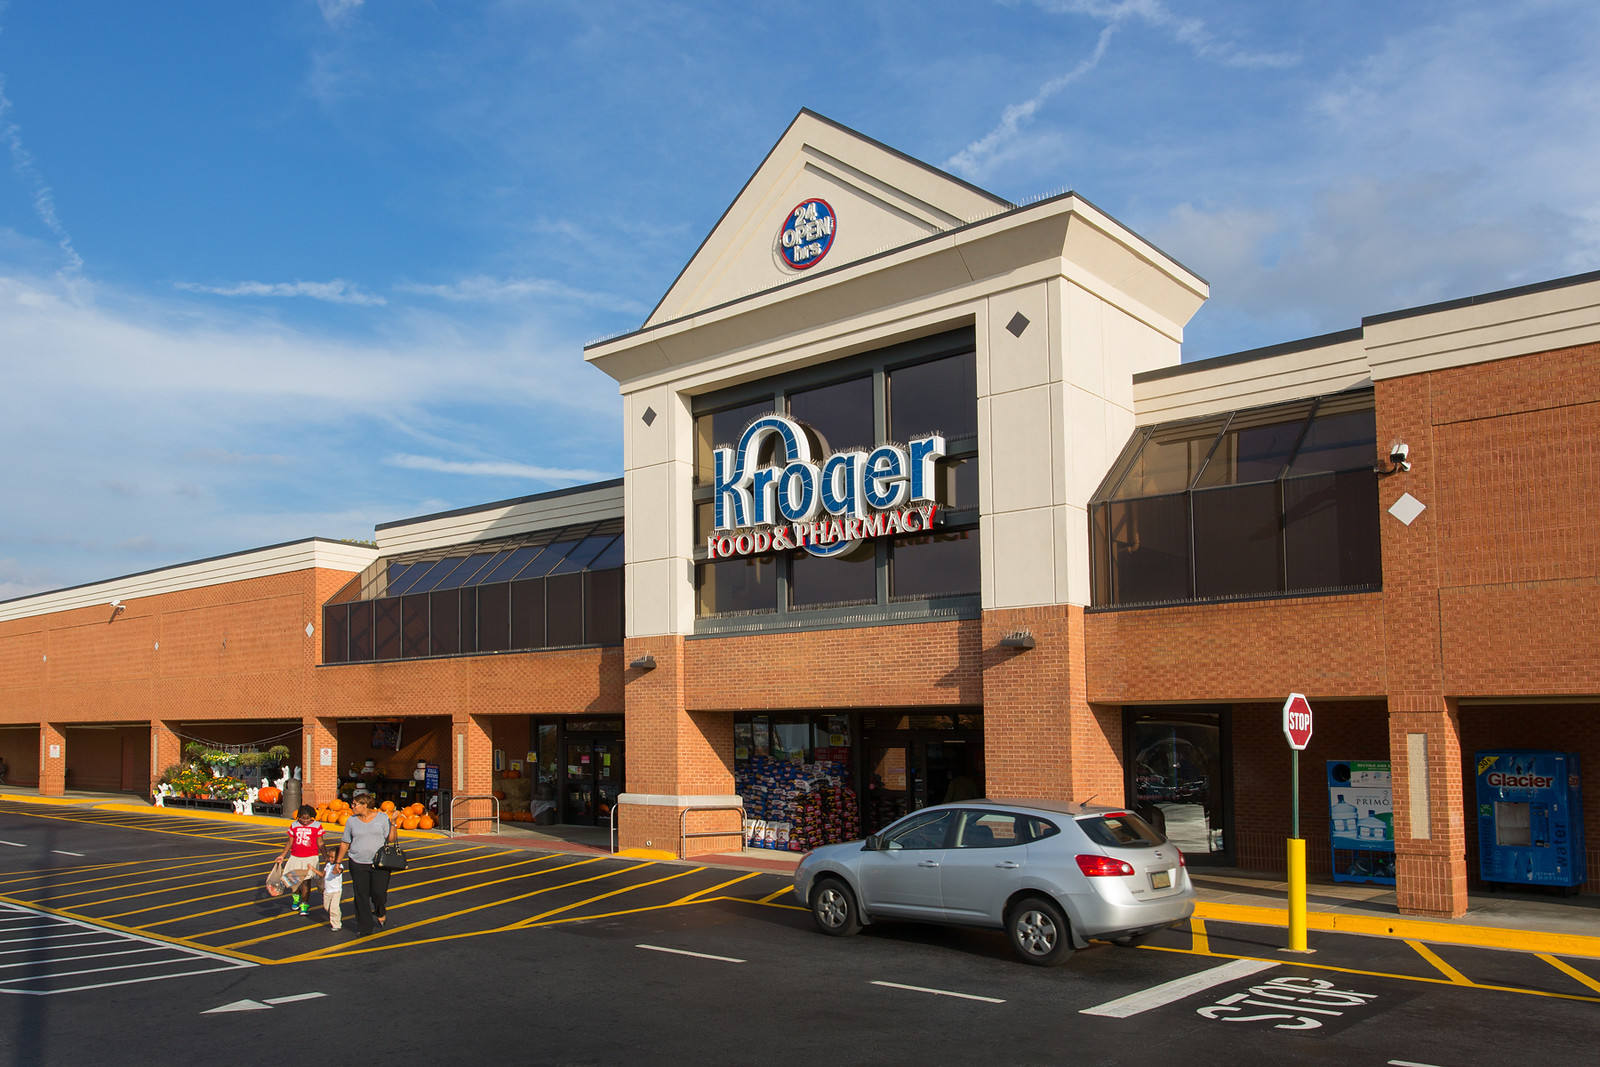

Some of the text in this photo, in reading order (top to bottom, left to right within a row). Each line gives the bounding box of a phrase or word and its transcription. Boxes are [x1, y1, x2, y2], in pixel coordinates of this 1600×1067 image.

[794, 202, 817, 227] 24
[782, 216, 832, 248] OPEN
[794, 242, 822, 262] hrs
[714, 414, 946, 557] Kroger
[707, 531, 772, 559] FOOD
[795, 505, 938, 547] PHARMACY
[1289, 711, 1310, 731] STOP
[1488, 773, 1553, 788] Glacier
[1355, 798, 1390, 806] PRIMO
[1553, 823, 1568, 868] water
[1196, 976, 1379, 1030] STOP
